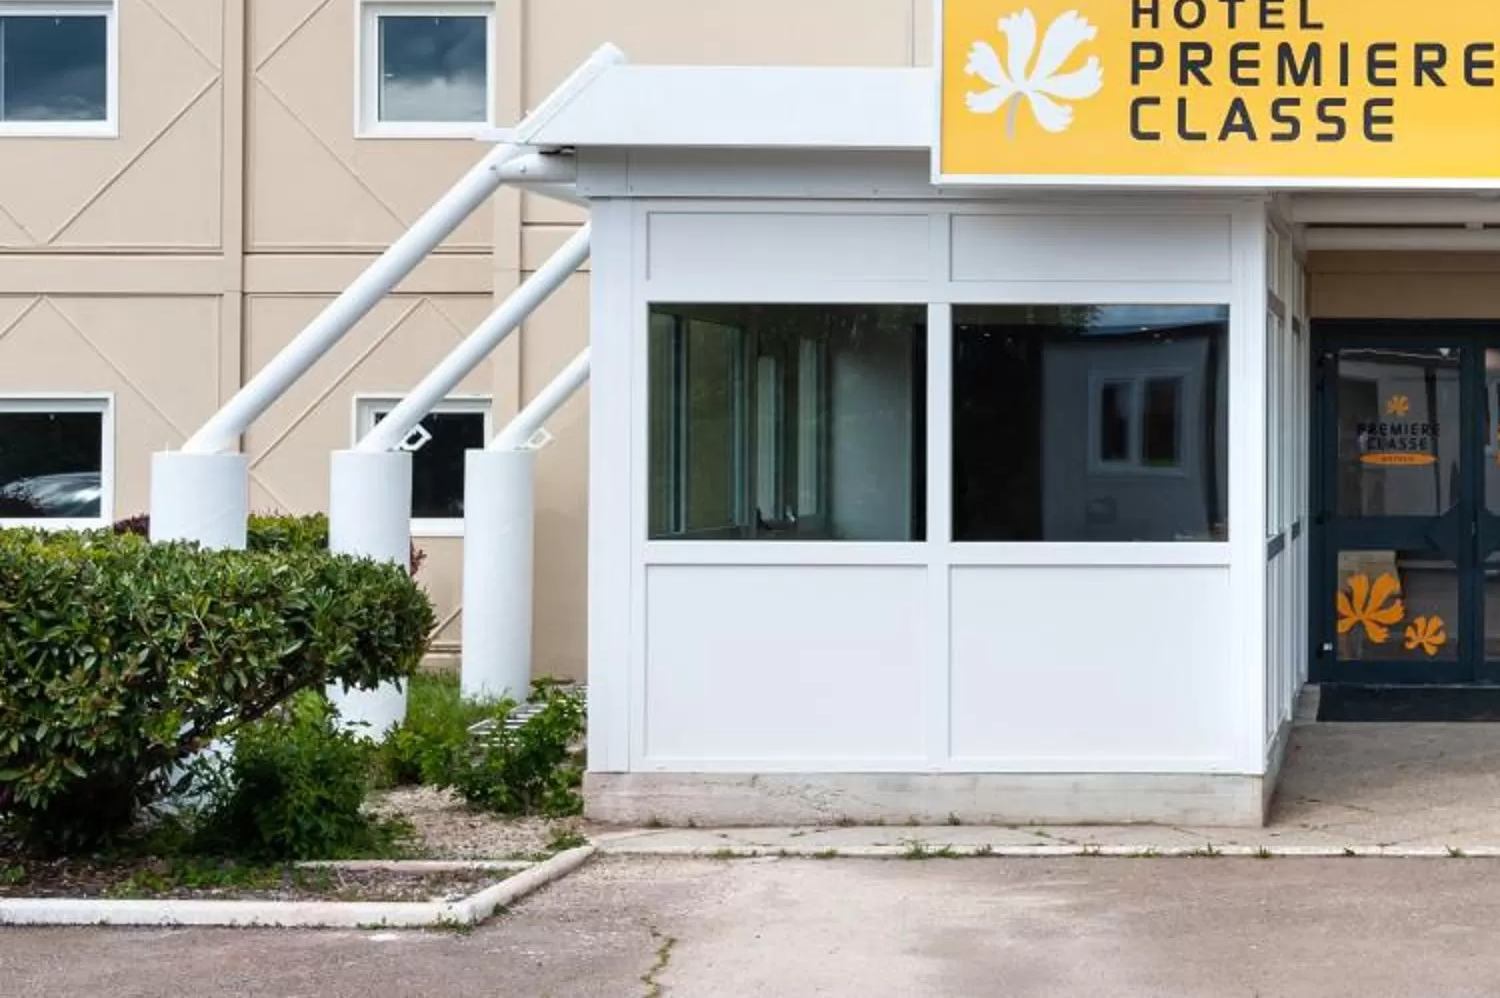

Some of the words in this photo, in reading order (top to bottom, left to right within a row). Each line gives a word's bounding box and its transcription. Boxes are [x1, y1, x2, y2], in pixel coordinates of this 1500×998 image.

[1130, 41, 1495, 87] PREMIERE
[1129, 97, 1395, 143] CLASSE
[1357, 422, 1440, 436] PREMIERE
[1366, 437, 1428, 451] CLASSE
